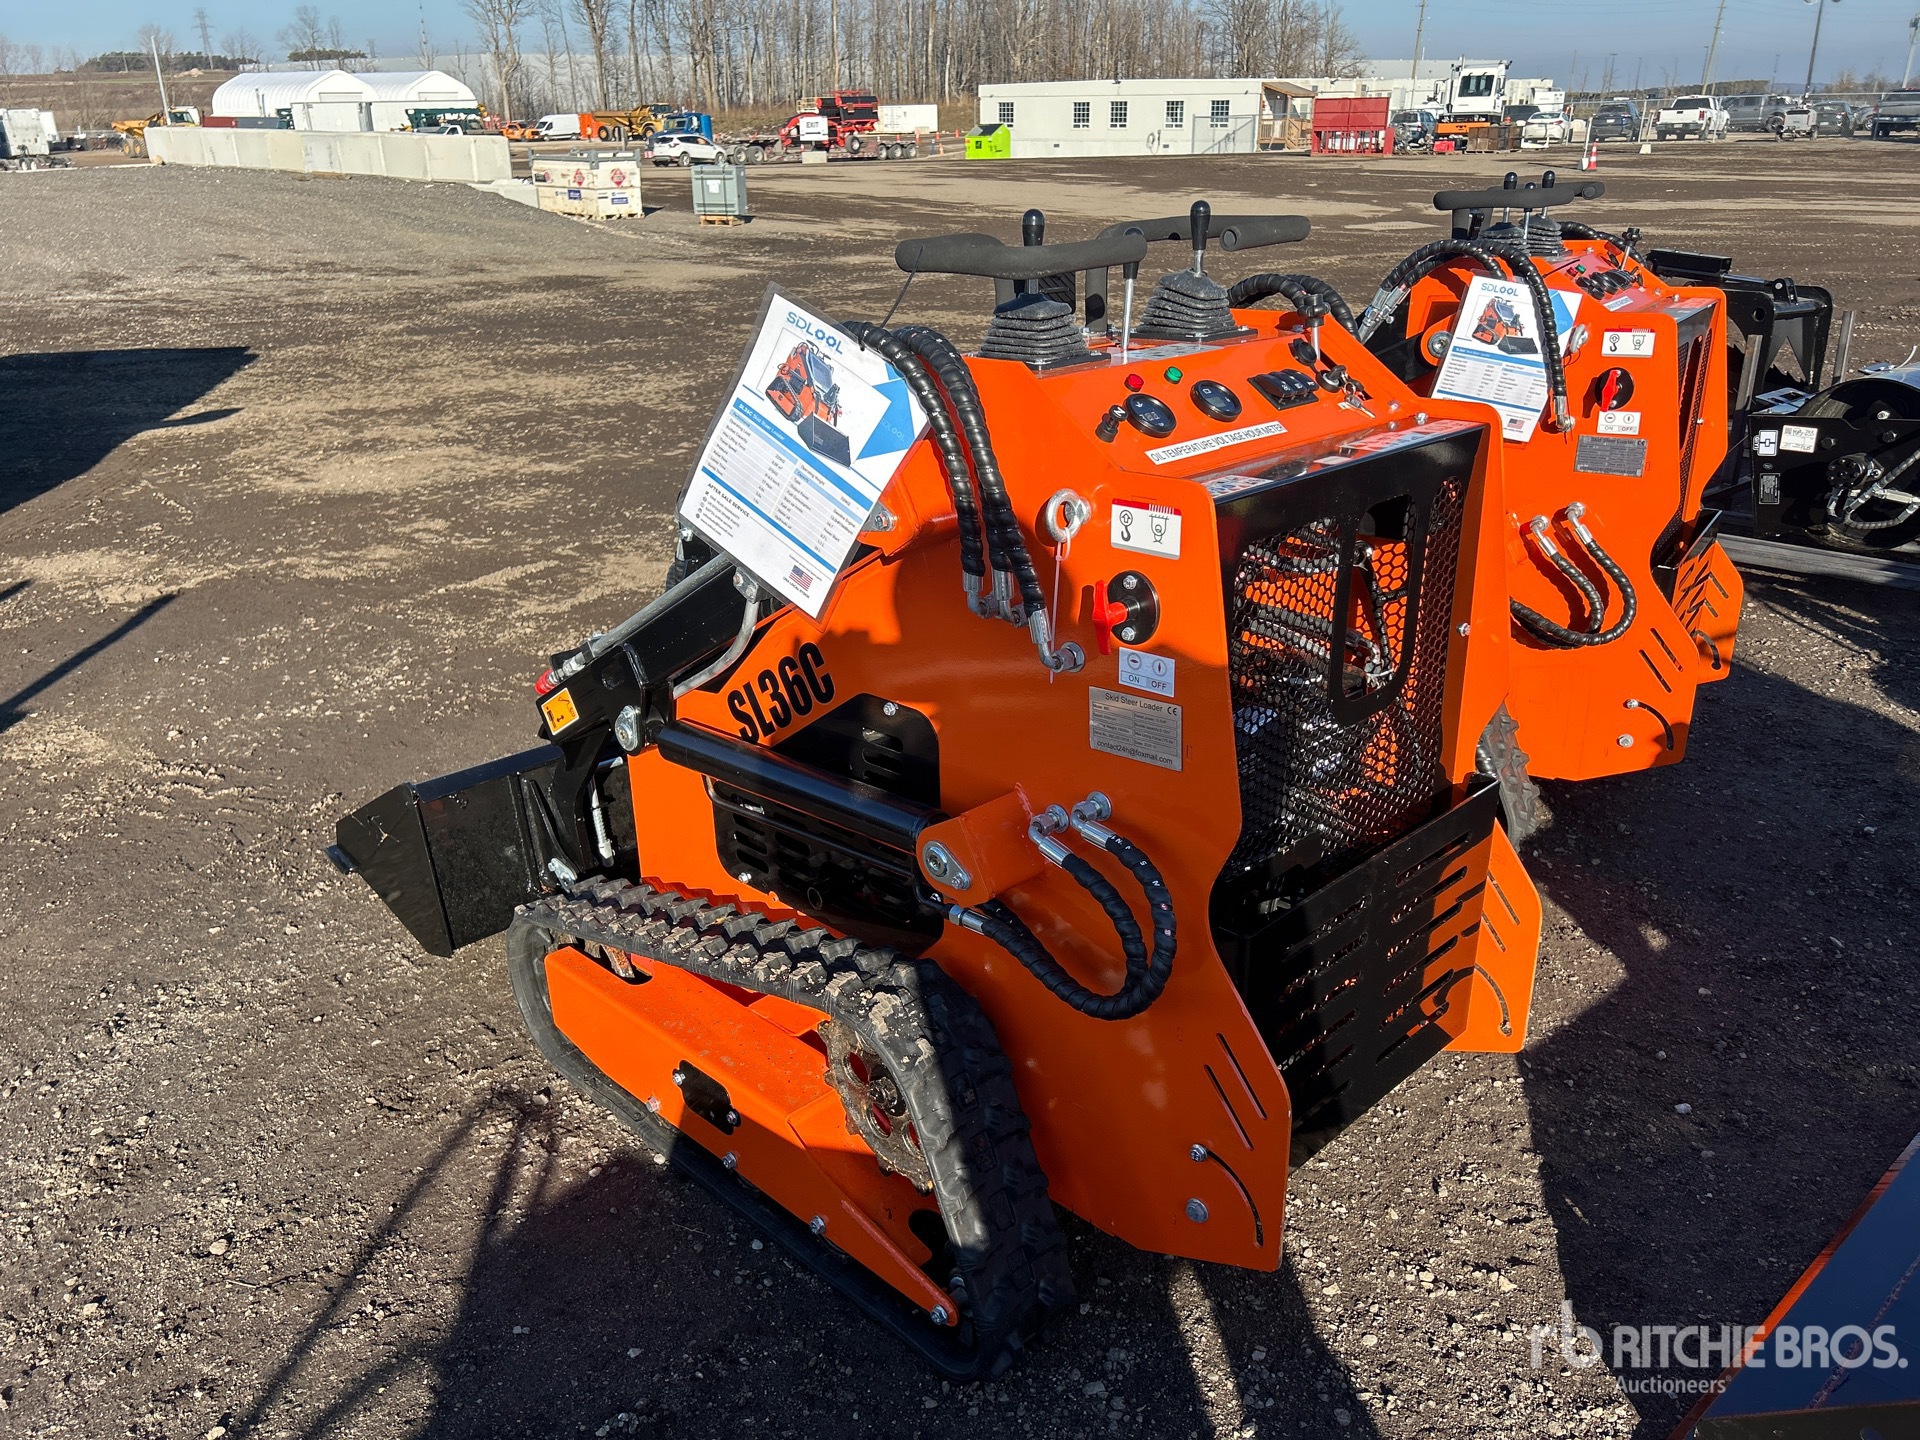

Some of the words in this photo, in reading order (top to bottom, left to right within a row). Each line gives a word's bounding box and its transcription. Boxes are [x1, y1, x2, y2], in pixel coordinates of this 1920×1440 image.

[1481, 283, 1518, 296] SDLOOL
[787, 312, 842, 354] SDLOOL
[1151, 452, 1166, 462] OIL
[1164, 440, 1213, 458] TEMPERATURE
[1212, 432, 1246, 445] VOLTAGE
[1244, 428, 1265, 438] HOUR
[1262, 424, 1283, 435] METER
[707, 482, 721, 495] AFTER
[720, 493, 732, 504] SALE
[731, 501, 749, 517] SERVICE
[727, 643, 835, 744] SL36C
[1129, 675, 1140, 683] ON
[1151, 681, 1167, 690] OFF
[1105, 693, 1119, 702] Skid
[1121, 697, 1138, 706] Steer
[1140, 701, 1163, 712] Loader
[1167, 706, 1177, 716] CE
[1097, 740, 1173, 765] contact24h@foxmail.com
